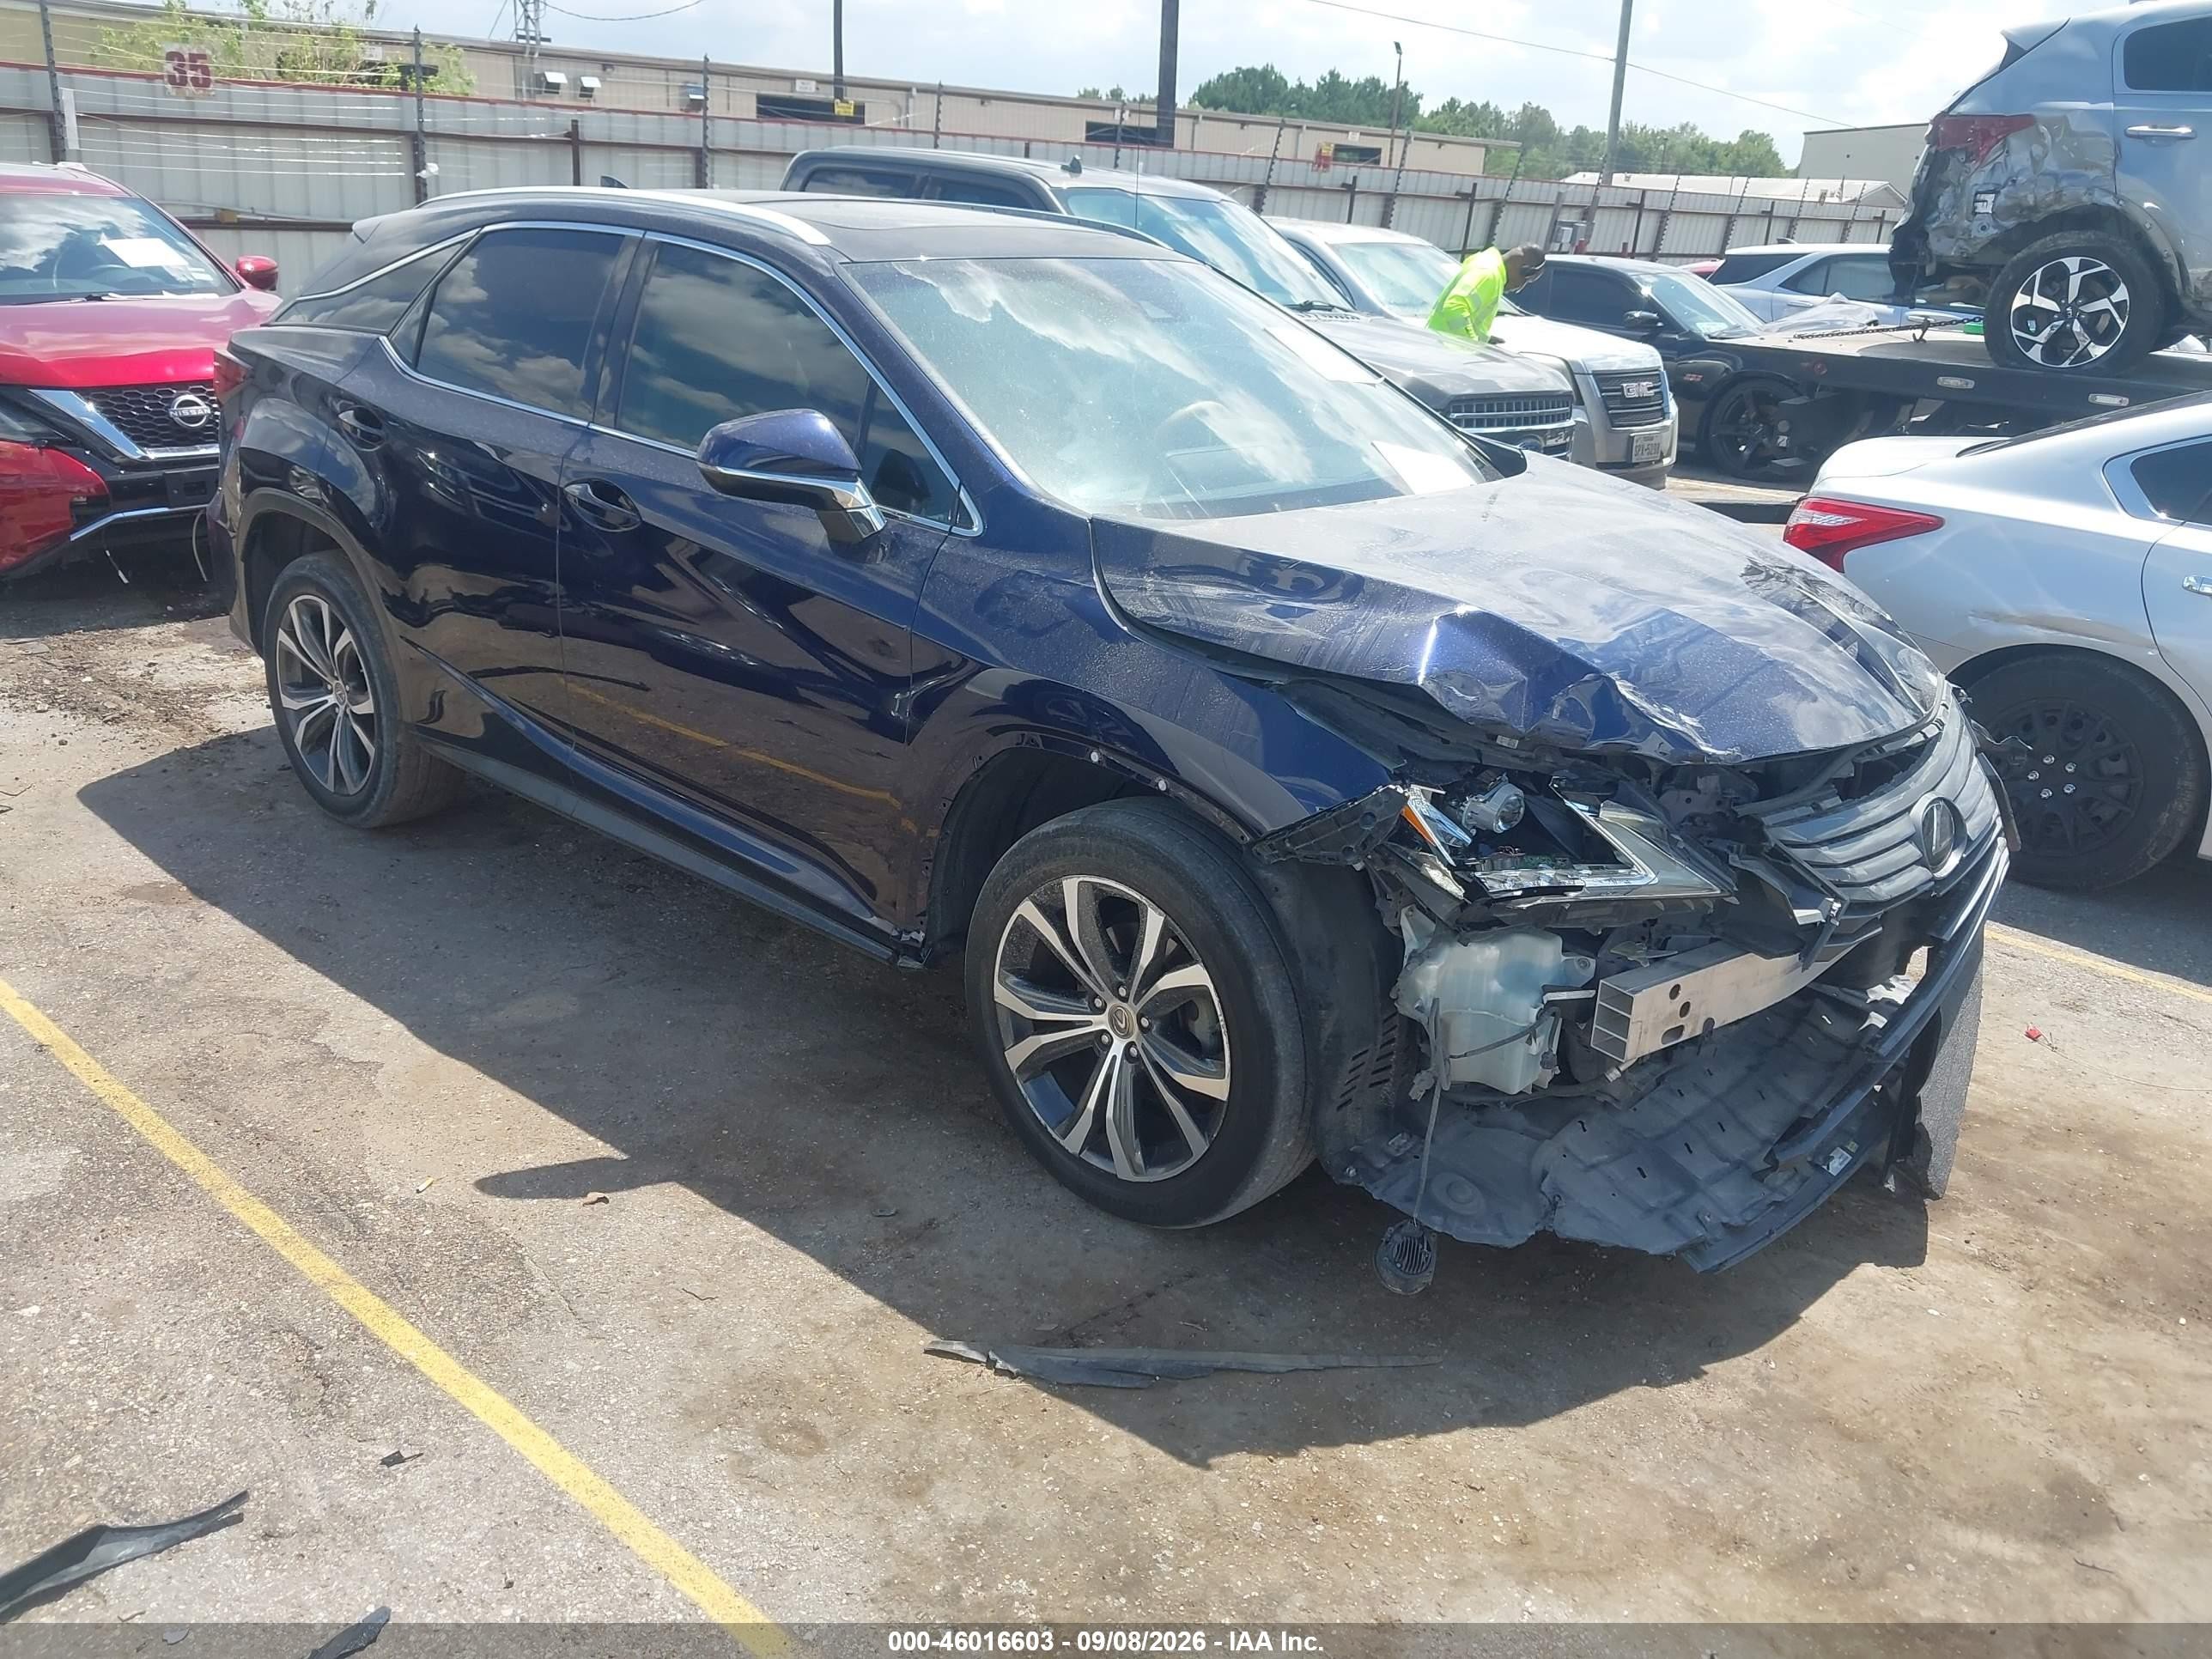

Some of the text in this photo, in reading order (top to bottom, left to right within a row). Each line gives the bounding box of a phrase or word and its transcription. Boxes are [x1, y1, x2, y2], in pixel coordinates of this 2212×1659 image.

[165, 52, 212, 88] 35
[1621, 382, 1655, 398] GMC
[169, 406, 211, 417] NISSAN
